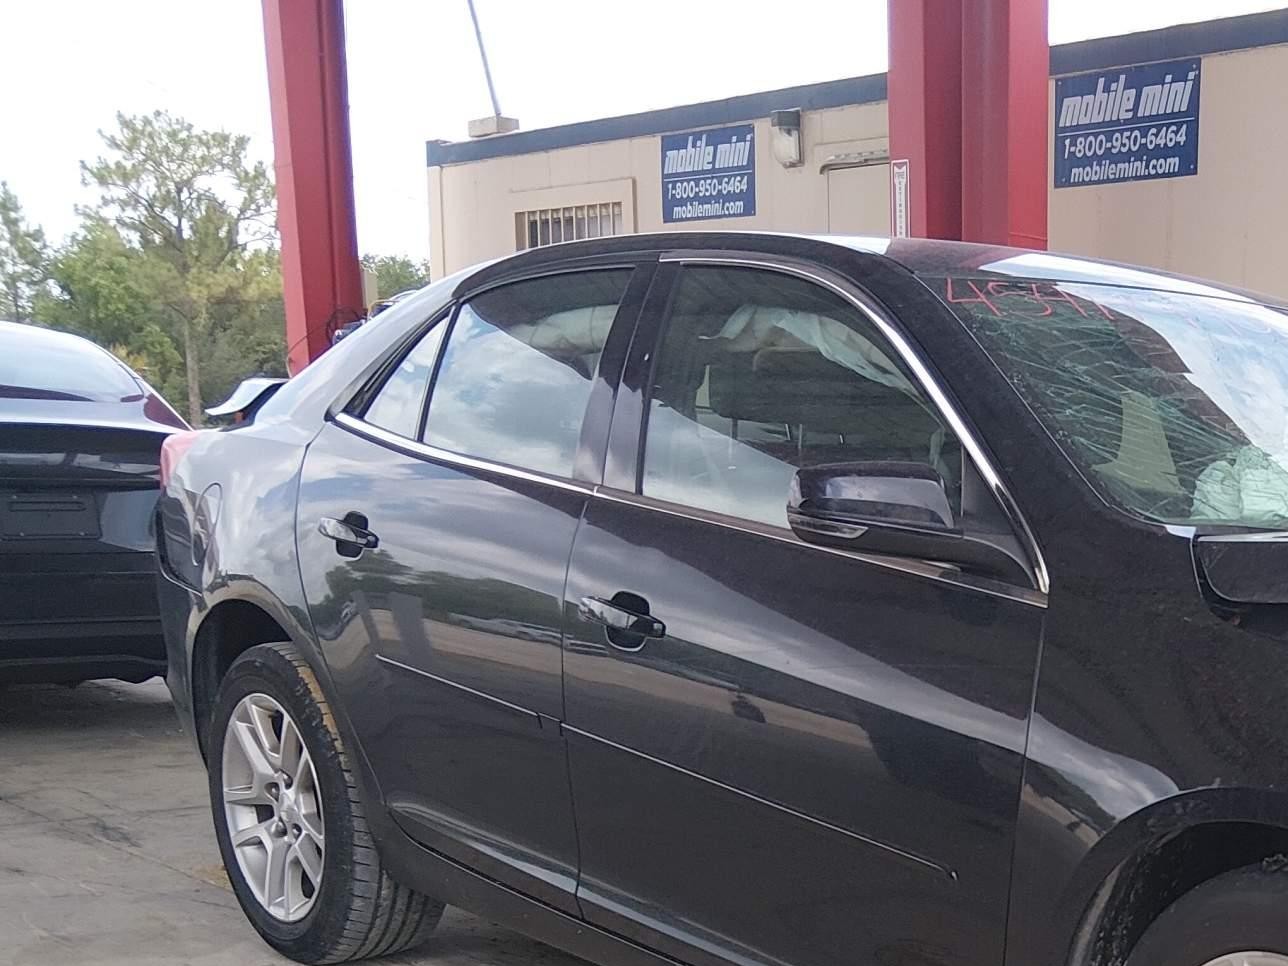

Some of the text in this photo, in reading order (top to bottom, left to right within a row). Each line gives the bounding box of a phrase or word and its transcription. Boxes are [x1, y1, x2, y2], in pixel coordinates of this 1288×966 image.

[1059, 72, 1195, 127] mobile mini
[664, 134, 751, 174] mobile mini
[1064, 124, 1187, 159] 1-800-950-6464
[1070, 156, 1179, 182] mobilemini.com
[668, 176, 748, 200] 1-800-950-6464
[673, 200, 744, 219] mobilemini.com
